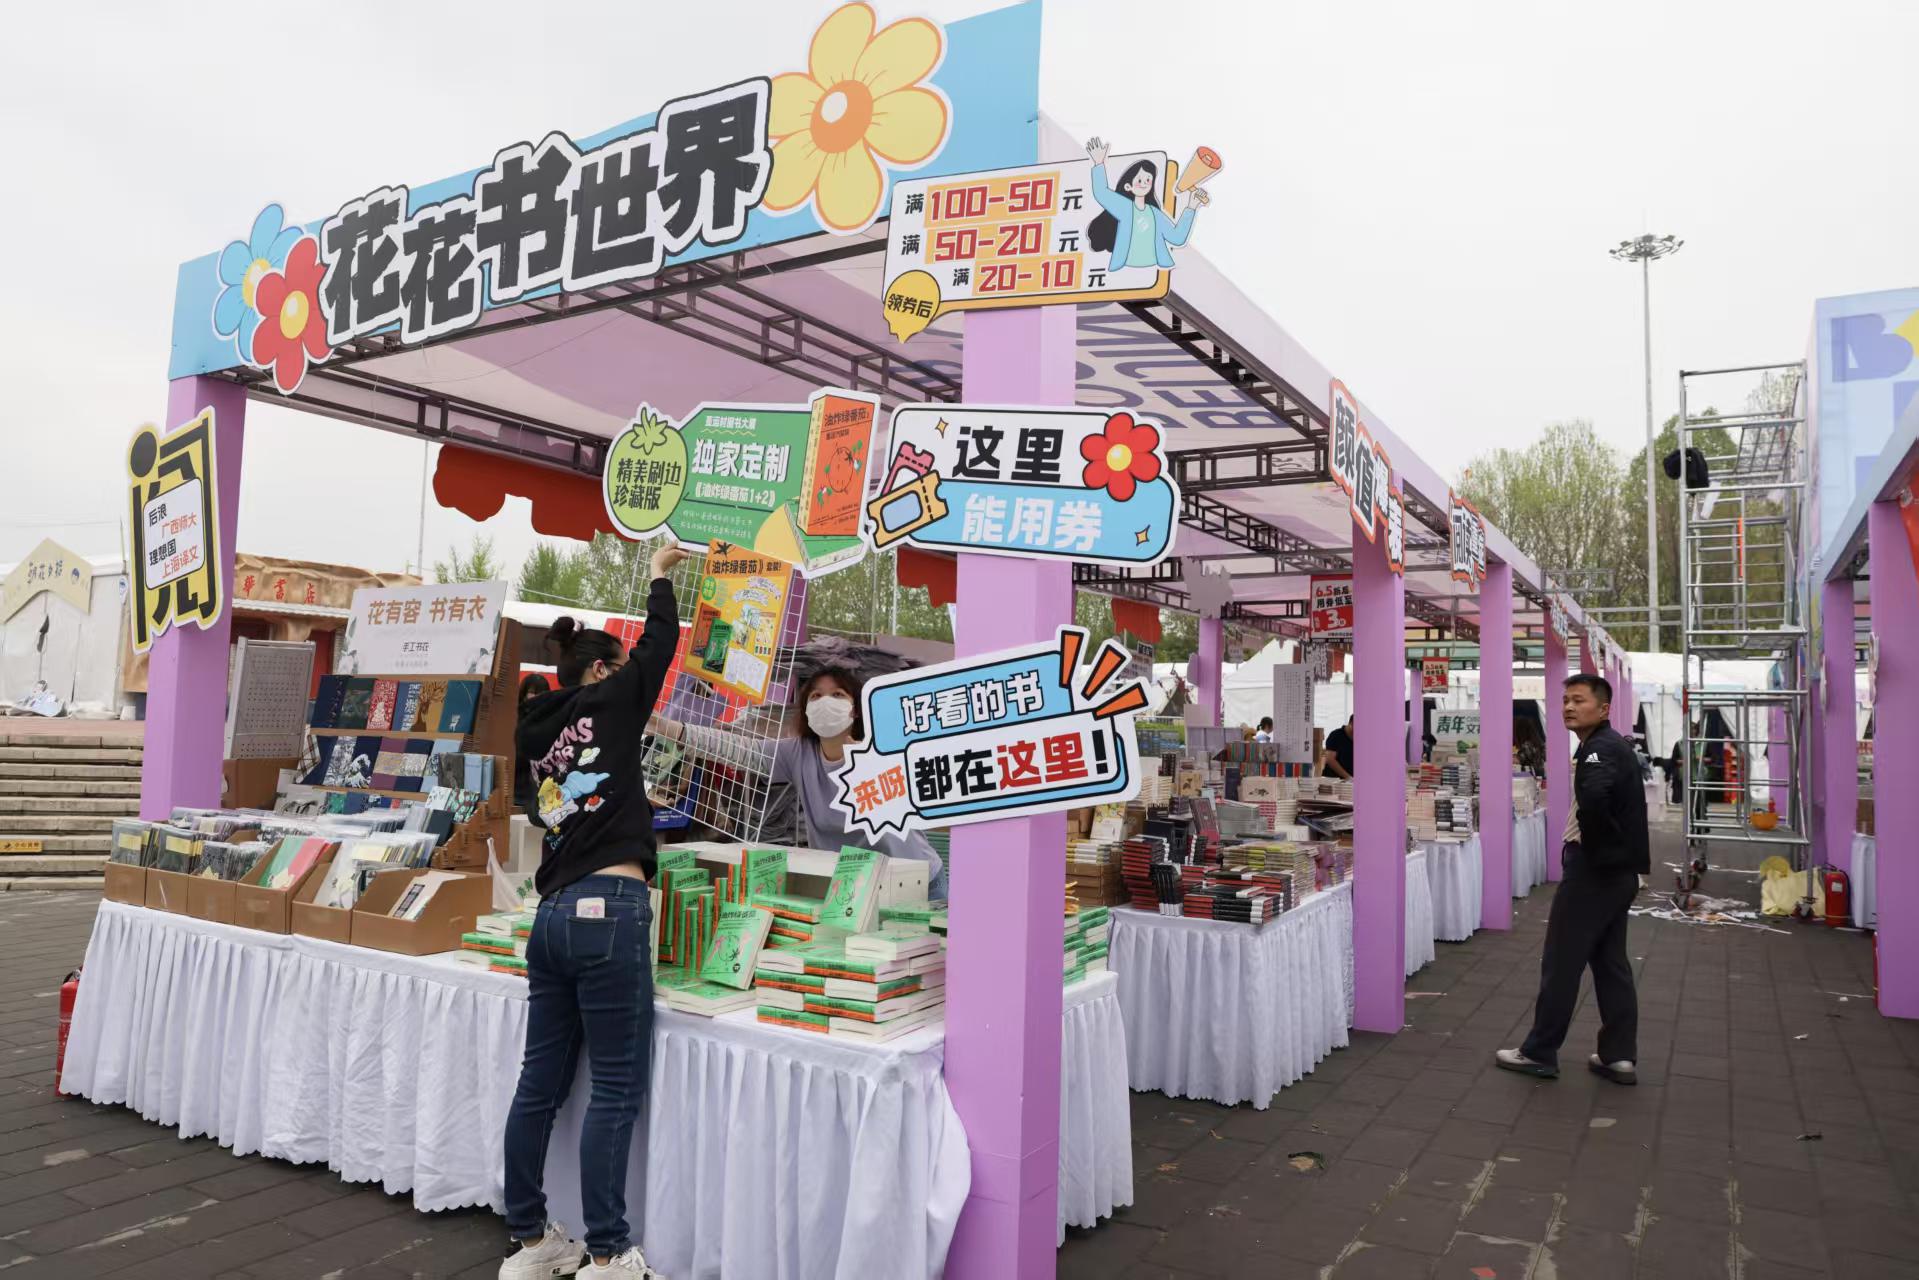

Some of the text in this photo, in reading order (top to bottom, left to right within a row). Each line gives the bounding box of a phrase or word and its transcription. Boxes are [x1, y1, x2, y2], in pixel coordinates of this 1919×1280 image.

[326, 92, 762, 335] 花花书世界
[887, 294, 934, 319] 领券后
[692, 438, 791, 483] 独家定制
[952, 425, 1063, 483] 这里
[616, 457, 681, 486] 精美刷边
[613, 484, 661, 511] 珍藏版
[149, 503, 167, 526] 后浪
[161, 511, 197, 538] 广西师大
[961, 494, 1102, 551] 能用券
[148, 538, 177, 566] 理想国
[162, 545, 199, 579] 上海译文
[368, 595, 487, 625] 花有容 书有衣
[901, 670, 1044, 736] 好看的书
[1437, 715, 1465, 734] 青年
[915, 729, 1109, 802] 都在这里!
[853, 765, 905, 814] 来呀
